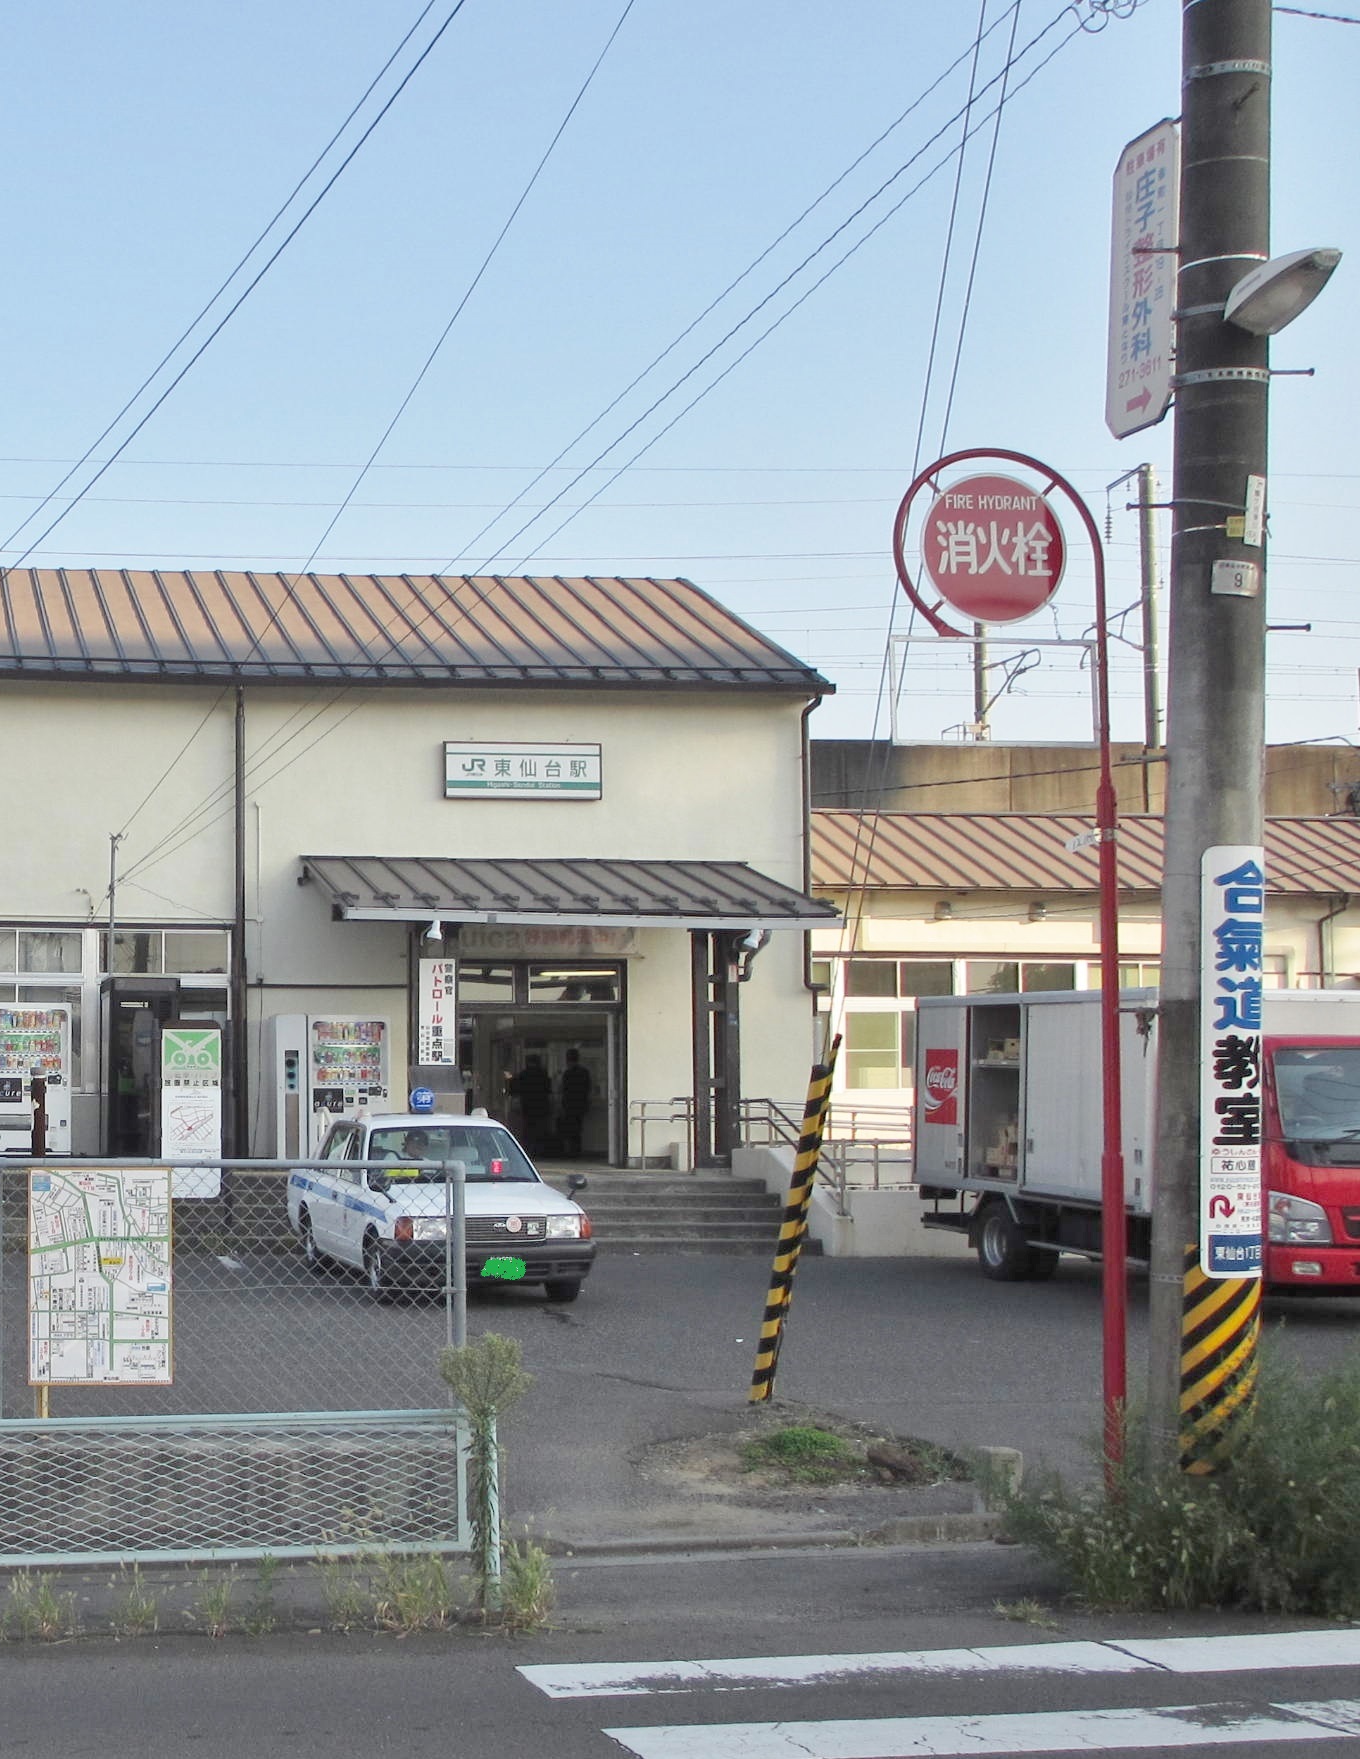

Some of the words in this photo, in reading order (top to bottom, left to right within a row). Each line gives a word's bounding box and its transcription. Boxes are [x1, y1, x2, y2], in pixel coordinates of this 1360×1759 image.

[1130, 167, 1157, 361] 庄子整形外科
[945, 494, 975, 511] FIRE
[978, 495, 1038, 512] HYDRANT
[936, 519, 1054, 578] 消火栓
[1234, 572, 1244, 588] 9
[461, 758, 486, 773] JR
[493, 758, 588, 779] 東仙台駅
[538, 782, 562, 790] Station
[431, 963, 444, 1063] パトロール重点駅
